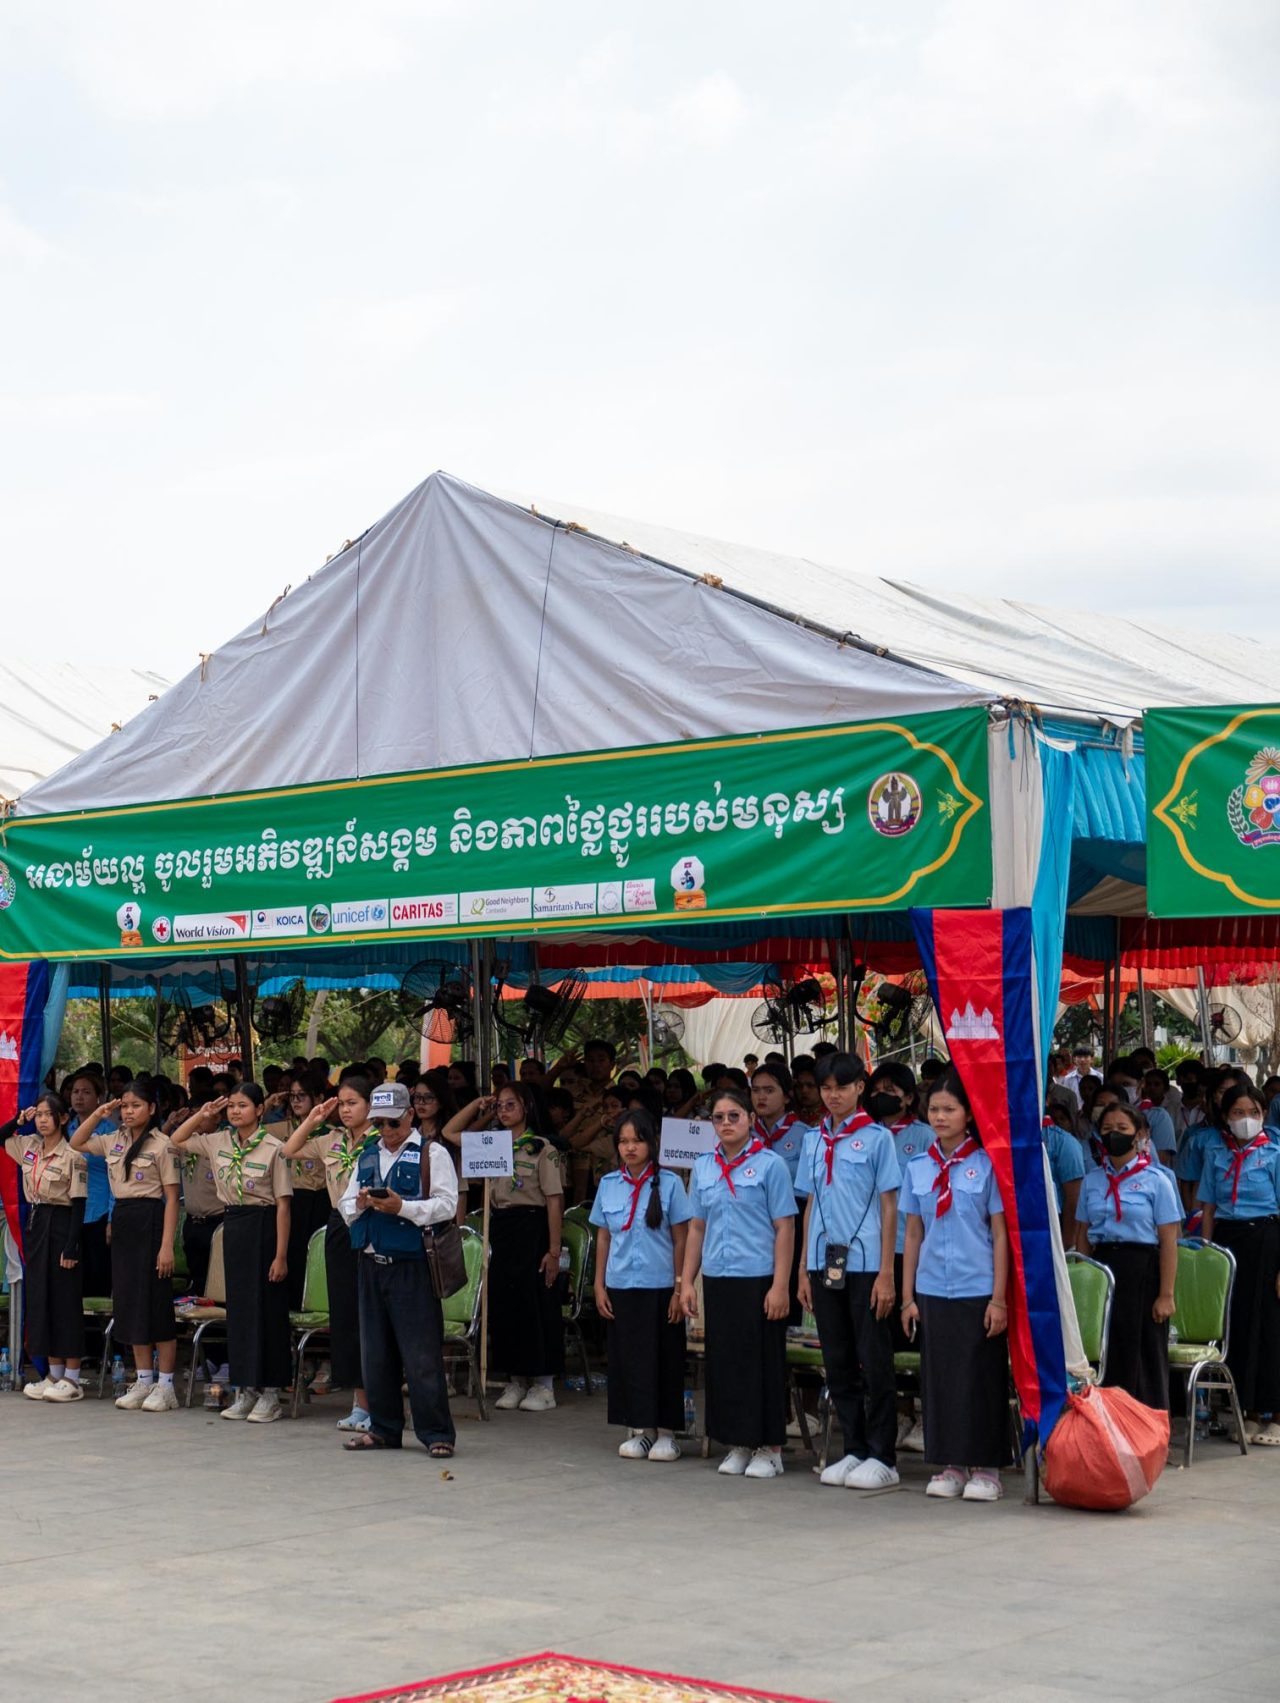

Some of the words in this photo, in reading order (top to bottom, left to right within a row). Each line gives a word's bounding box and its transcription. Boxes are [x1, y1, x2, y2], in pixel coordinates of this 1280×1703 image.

[26, 845, 146, 895] អនាម័យល្អ
[450, 780, 846, 868] និងភាពថ្លៃថ្នូររបស់មនុស្ស
[485, 897, 500, 906] Good
[501, 896, 529, 906] Neighbors
[534, 902, 574, 913] Samaritan's
[575, 901, 593, 910] Purse
[333, 905, 369, 924] unicef
[392, 902, 443, 921] CARITAS
[276, 915, 304, 926] KOICA
[176, 925, 204, 939] World
[206, 925, 235, 937] Vision
